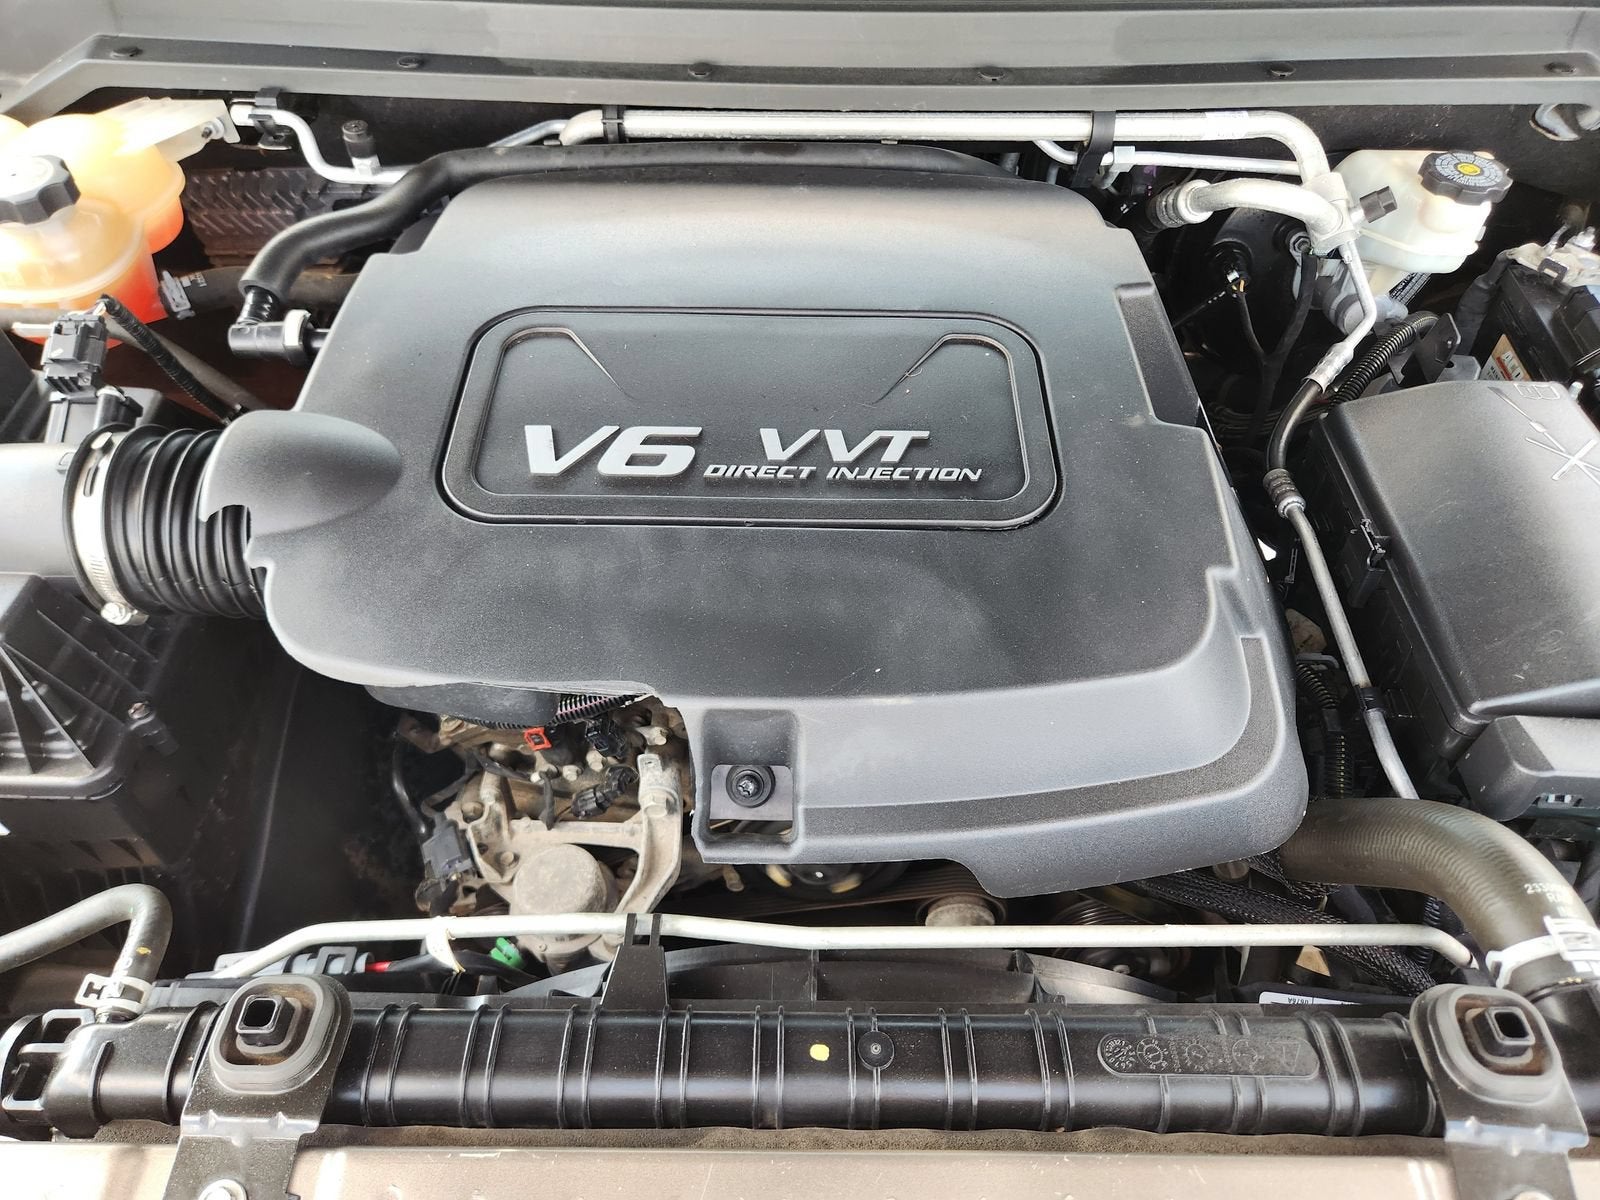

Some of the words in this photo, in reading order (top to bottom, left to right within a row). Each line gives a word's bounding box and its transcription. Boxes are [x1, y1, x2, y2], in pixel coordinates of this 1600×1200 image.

[524, 425, 703, 477] V6
[759, 428, 930, 463] VVT
[703, 464, 817, 479] DIRECT
[825, 466, 982, 482] INJECTION
